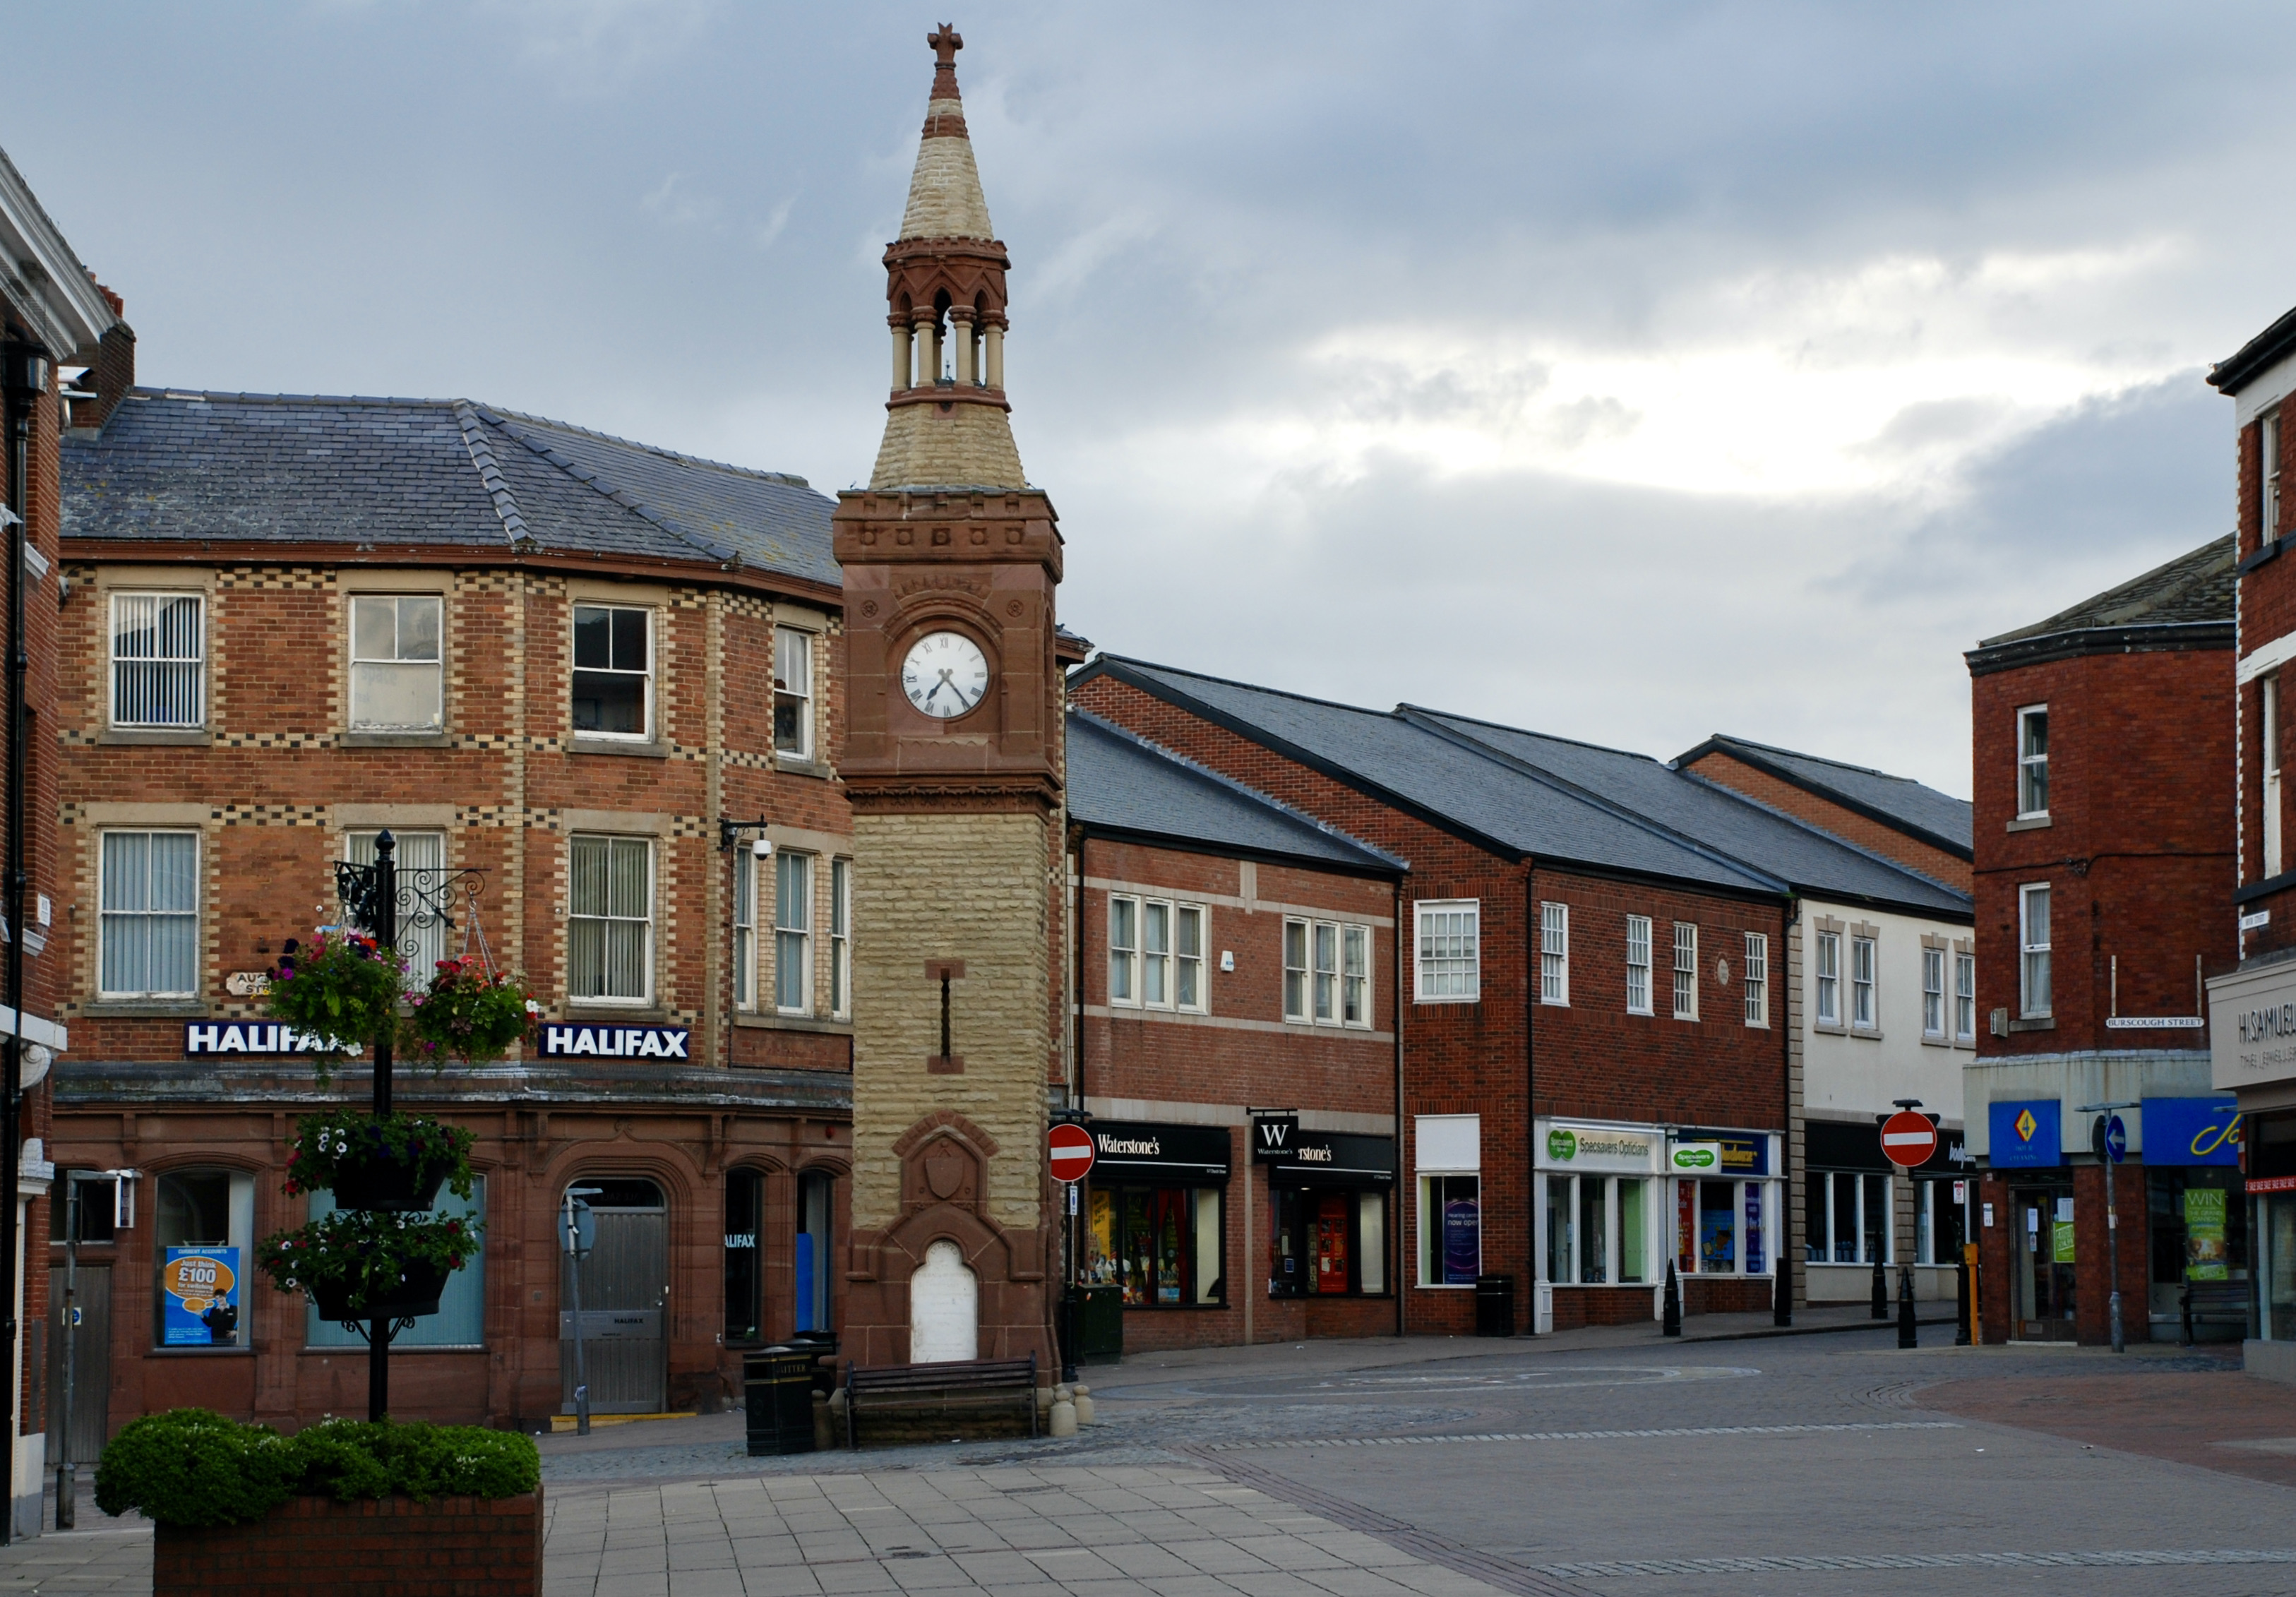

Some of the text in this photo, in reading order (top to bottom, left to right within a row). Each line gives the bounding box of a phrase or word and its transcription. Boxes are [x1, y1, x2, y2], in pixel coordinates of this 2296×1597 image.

[940, 637, 949, 649] XII
[547, 1027, 688, 1058] HALIFAX
[2021, 1115, 2030, 1137] 4
[1098, 1134, 1160, 1155] Waterstone's
[1260, 1125, 1289, 1147] W
[1580, 1137, 1649, 1156] Specsavers Opticians
[2187, 1192, 2223, 1206] WIN
[930, 1243, 958, 1255] ERECTED
[198, 1260, 216, 1269] think
[179, 1267, 216, 1284] £100
